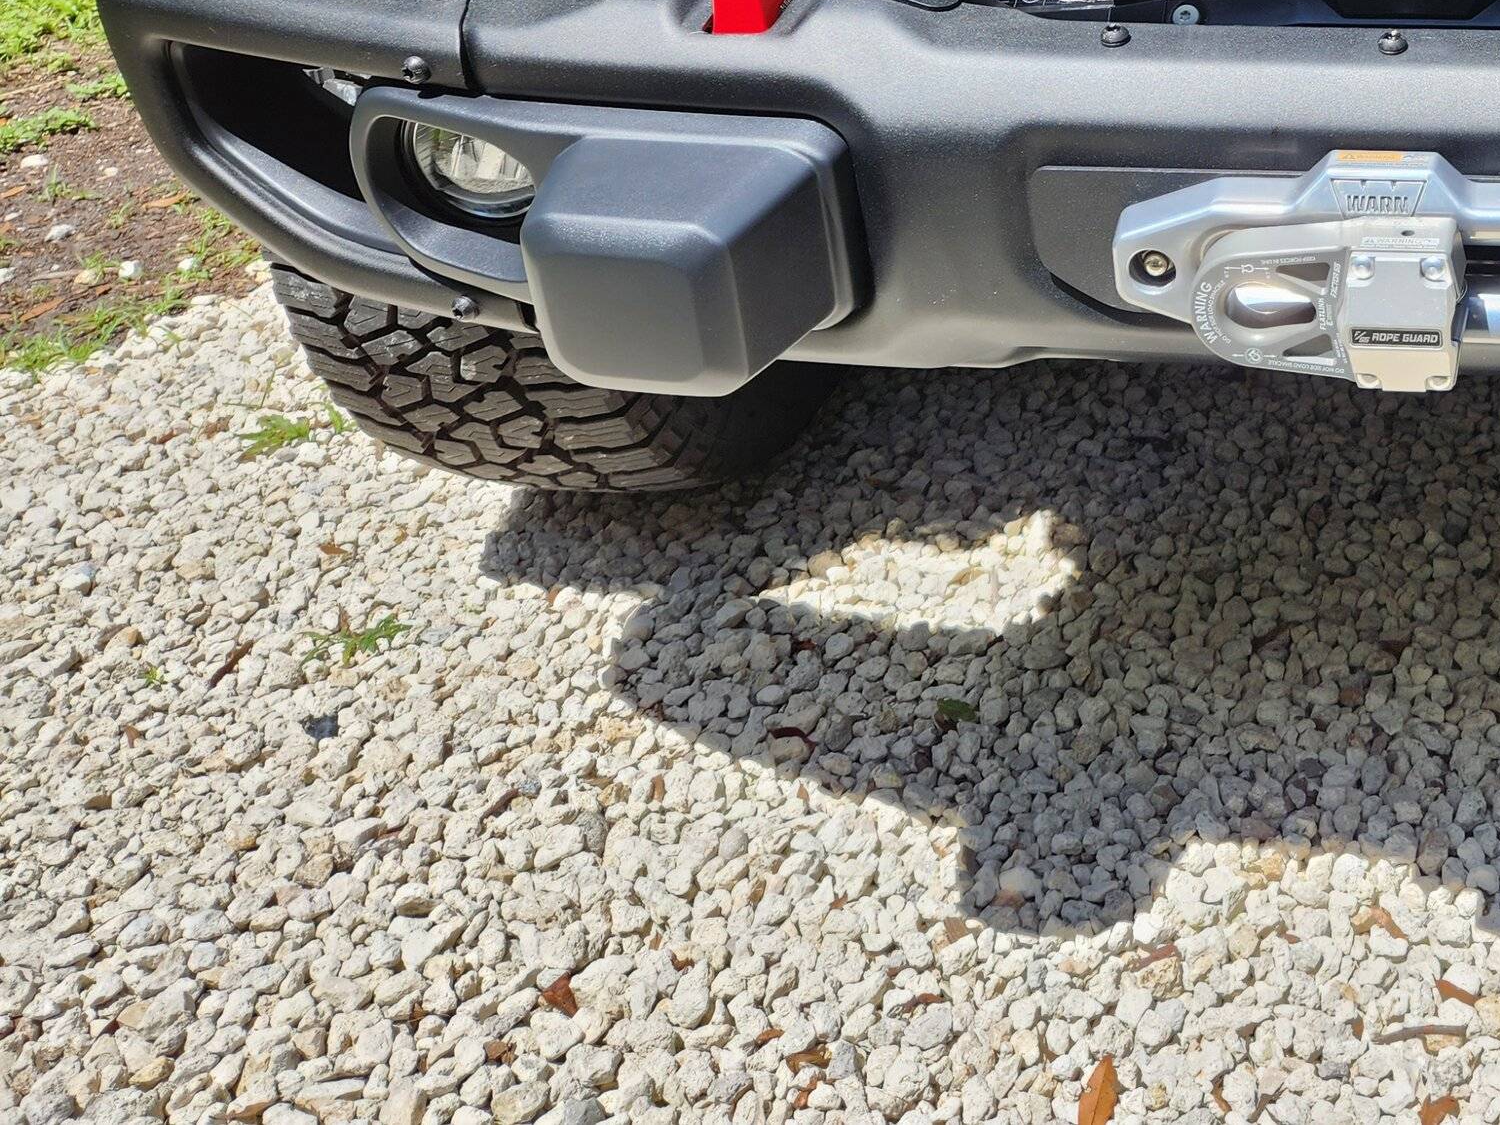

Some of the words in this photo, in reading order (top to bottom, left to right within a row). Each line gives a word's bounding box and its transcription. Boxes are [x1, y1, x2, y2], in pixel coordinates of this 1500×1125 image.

[1346, 195, 1408, 213] WARN
[1194, 281, 1218, 344] WARNING
[1372, 332, 1400, 342] ROPE
[1402, 334, 1438, 343] GUARD
